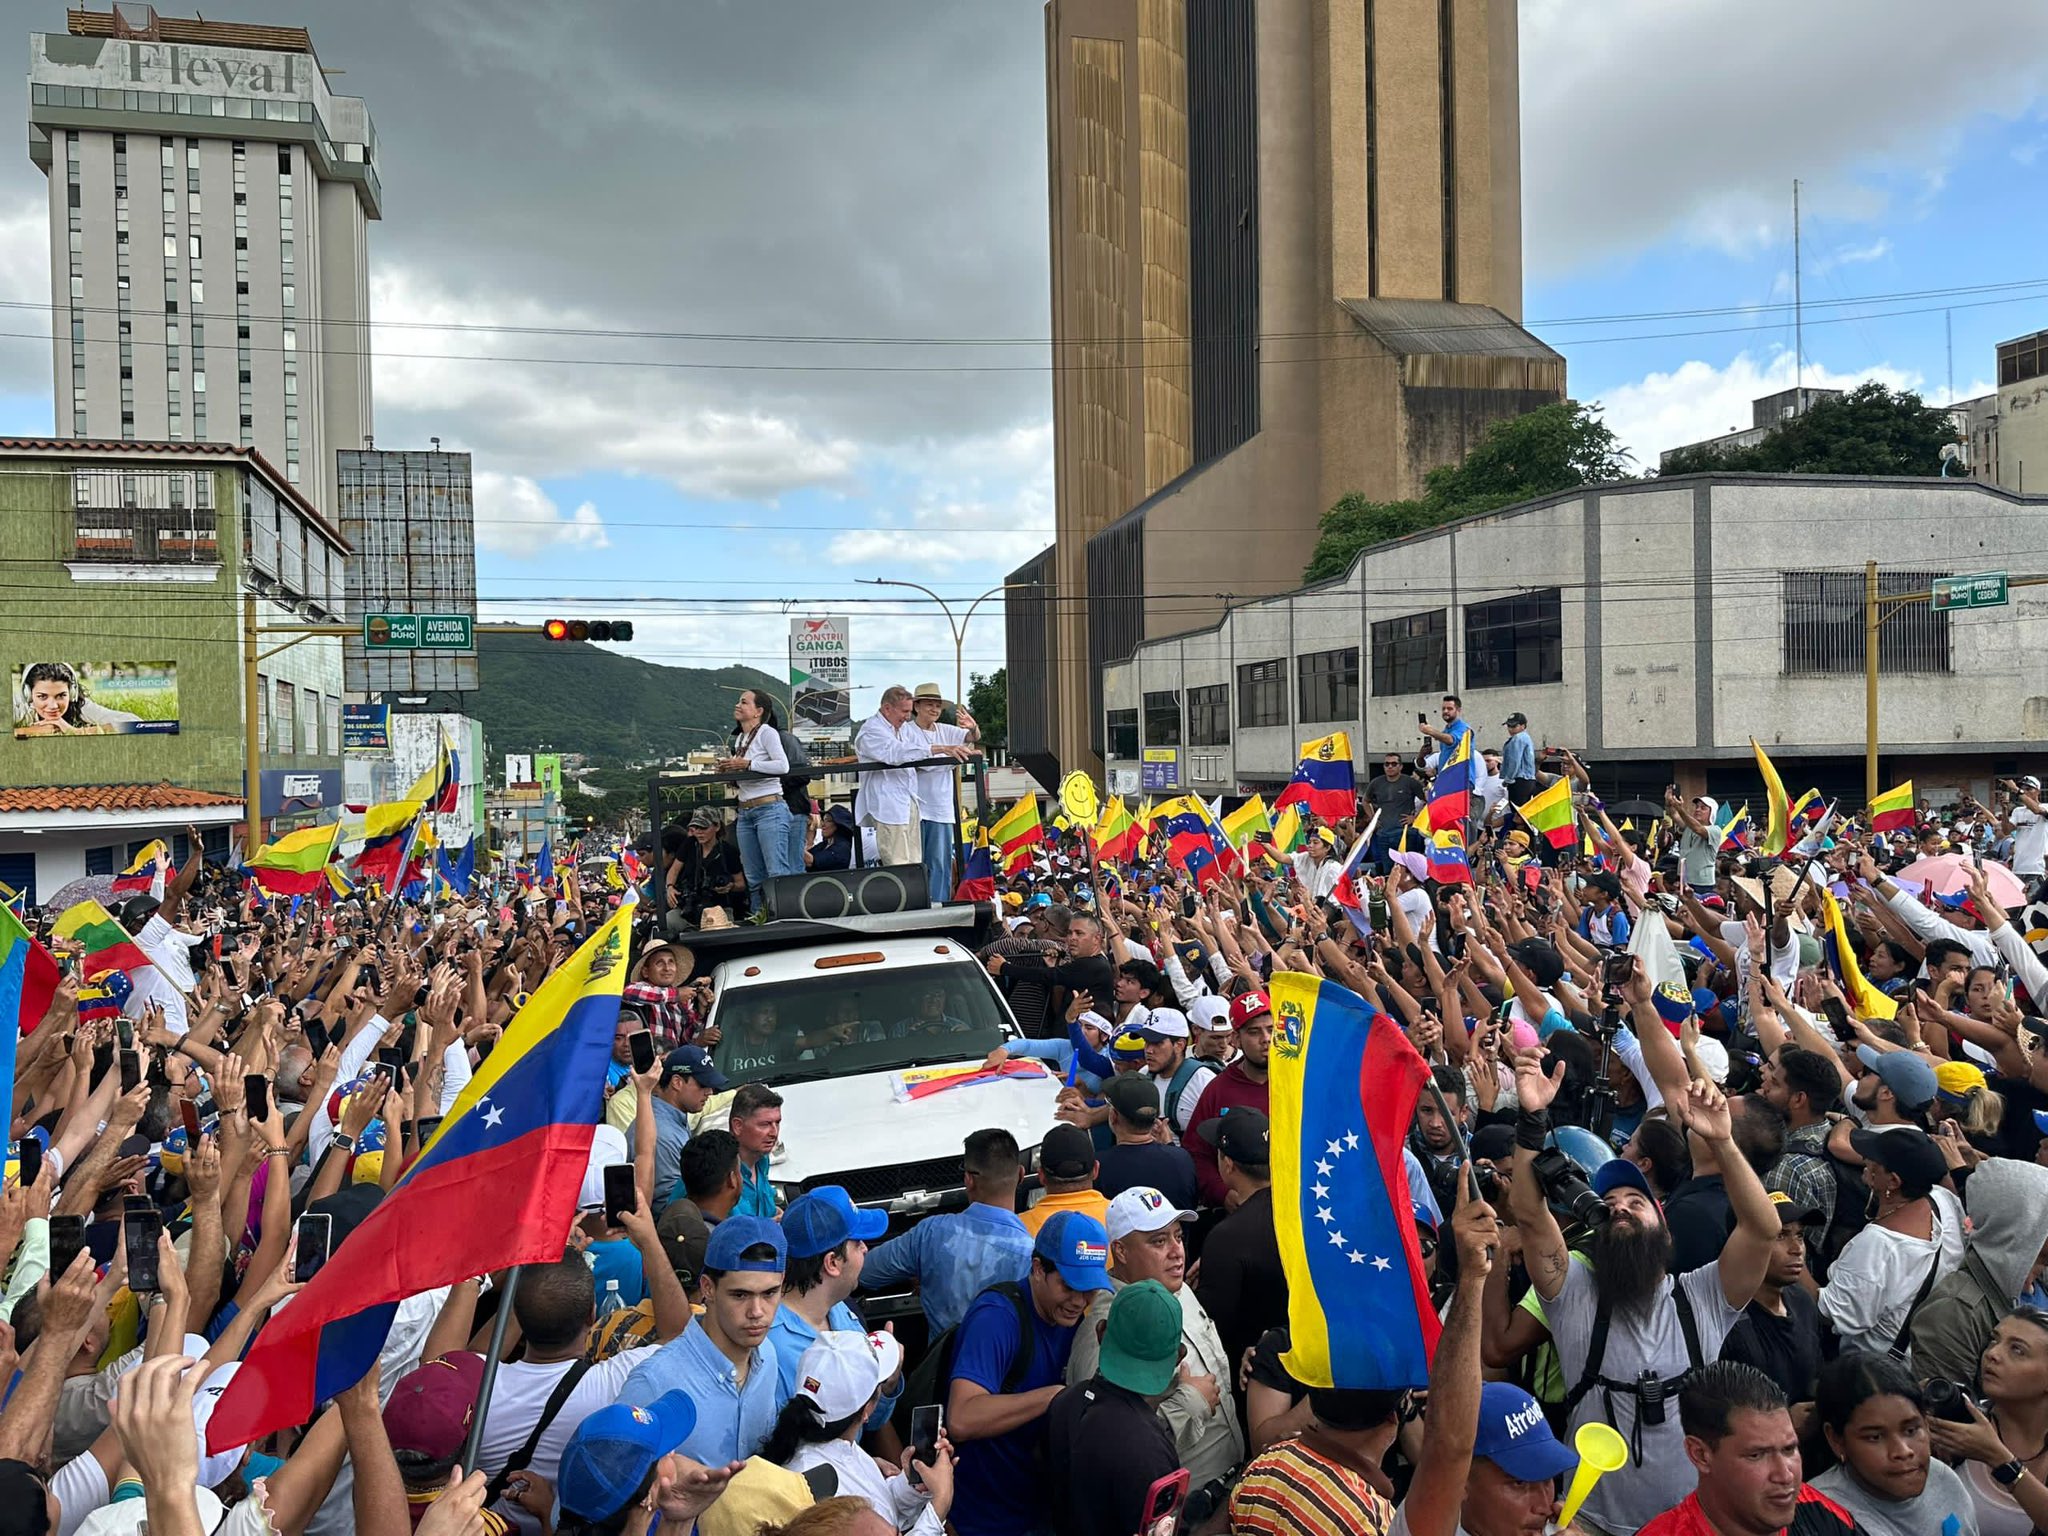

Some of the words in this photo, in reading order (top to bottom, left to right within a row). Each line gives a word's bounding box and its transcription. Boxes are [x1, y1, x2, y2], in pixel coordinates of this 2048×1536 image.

[1974, 579, 2001, 591] AVENIDA
[391, 623, 415, 631] PLAN
[426, 620, 463, 632] AVENIDA
[425, 632, 465, 642] CARABOBO
[796, 641, 844, 651] GANGA
[107, 677, 172, 689] experiencia
[1238, 783, 1269, 794] Kodak
